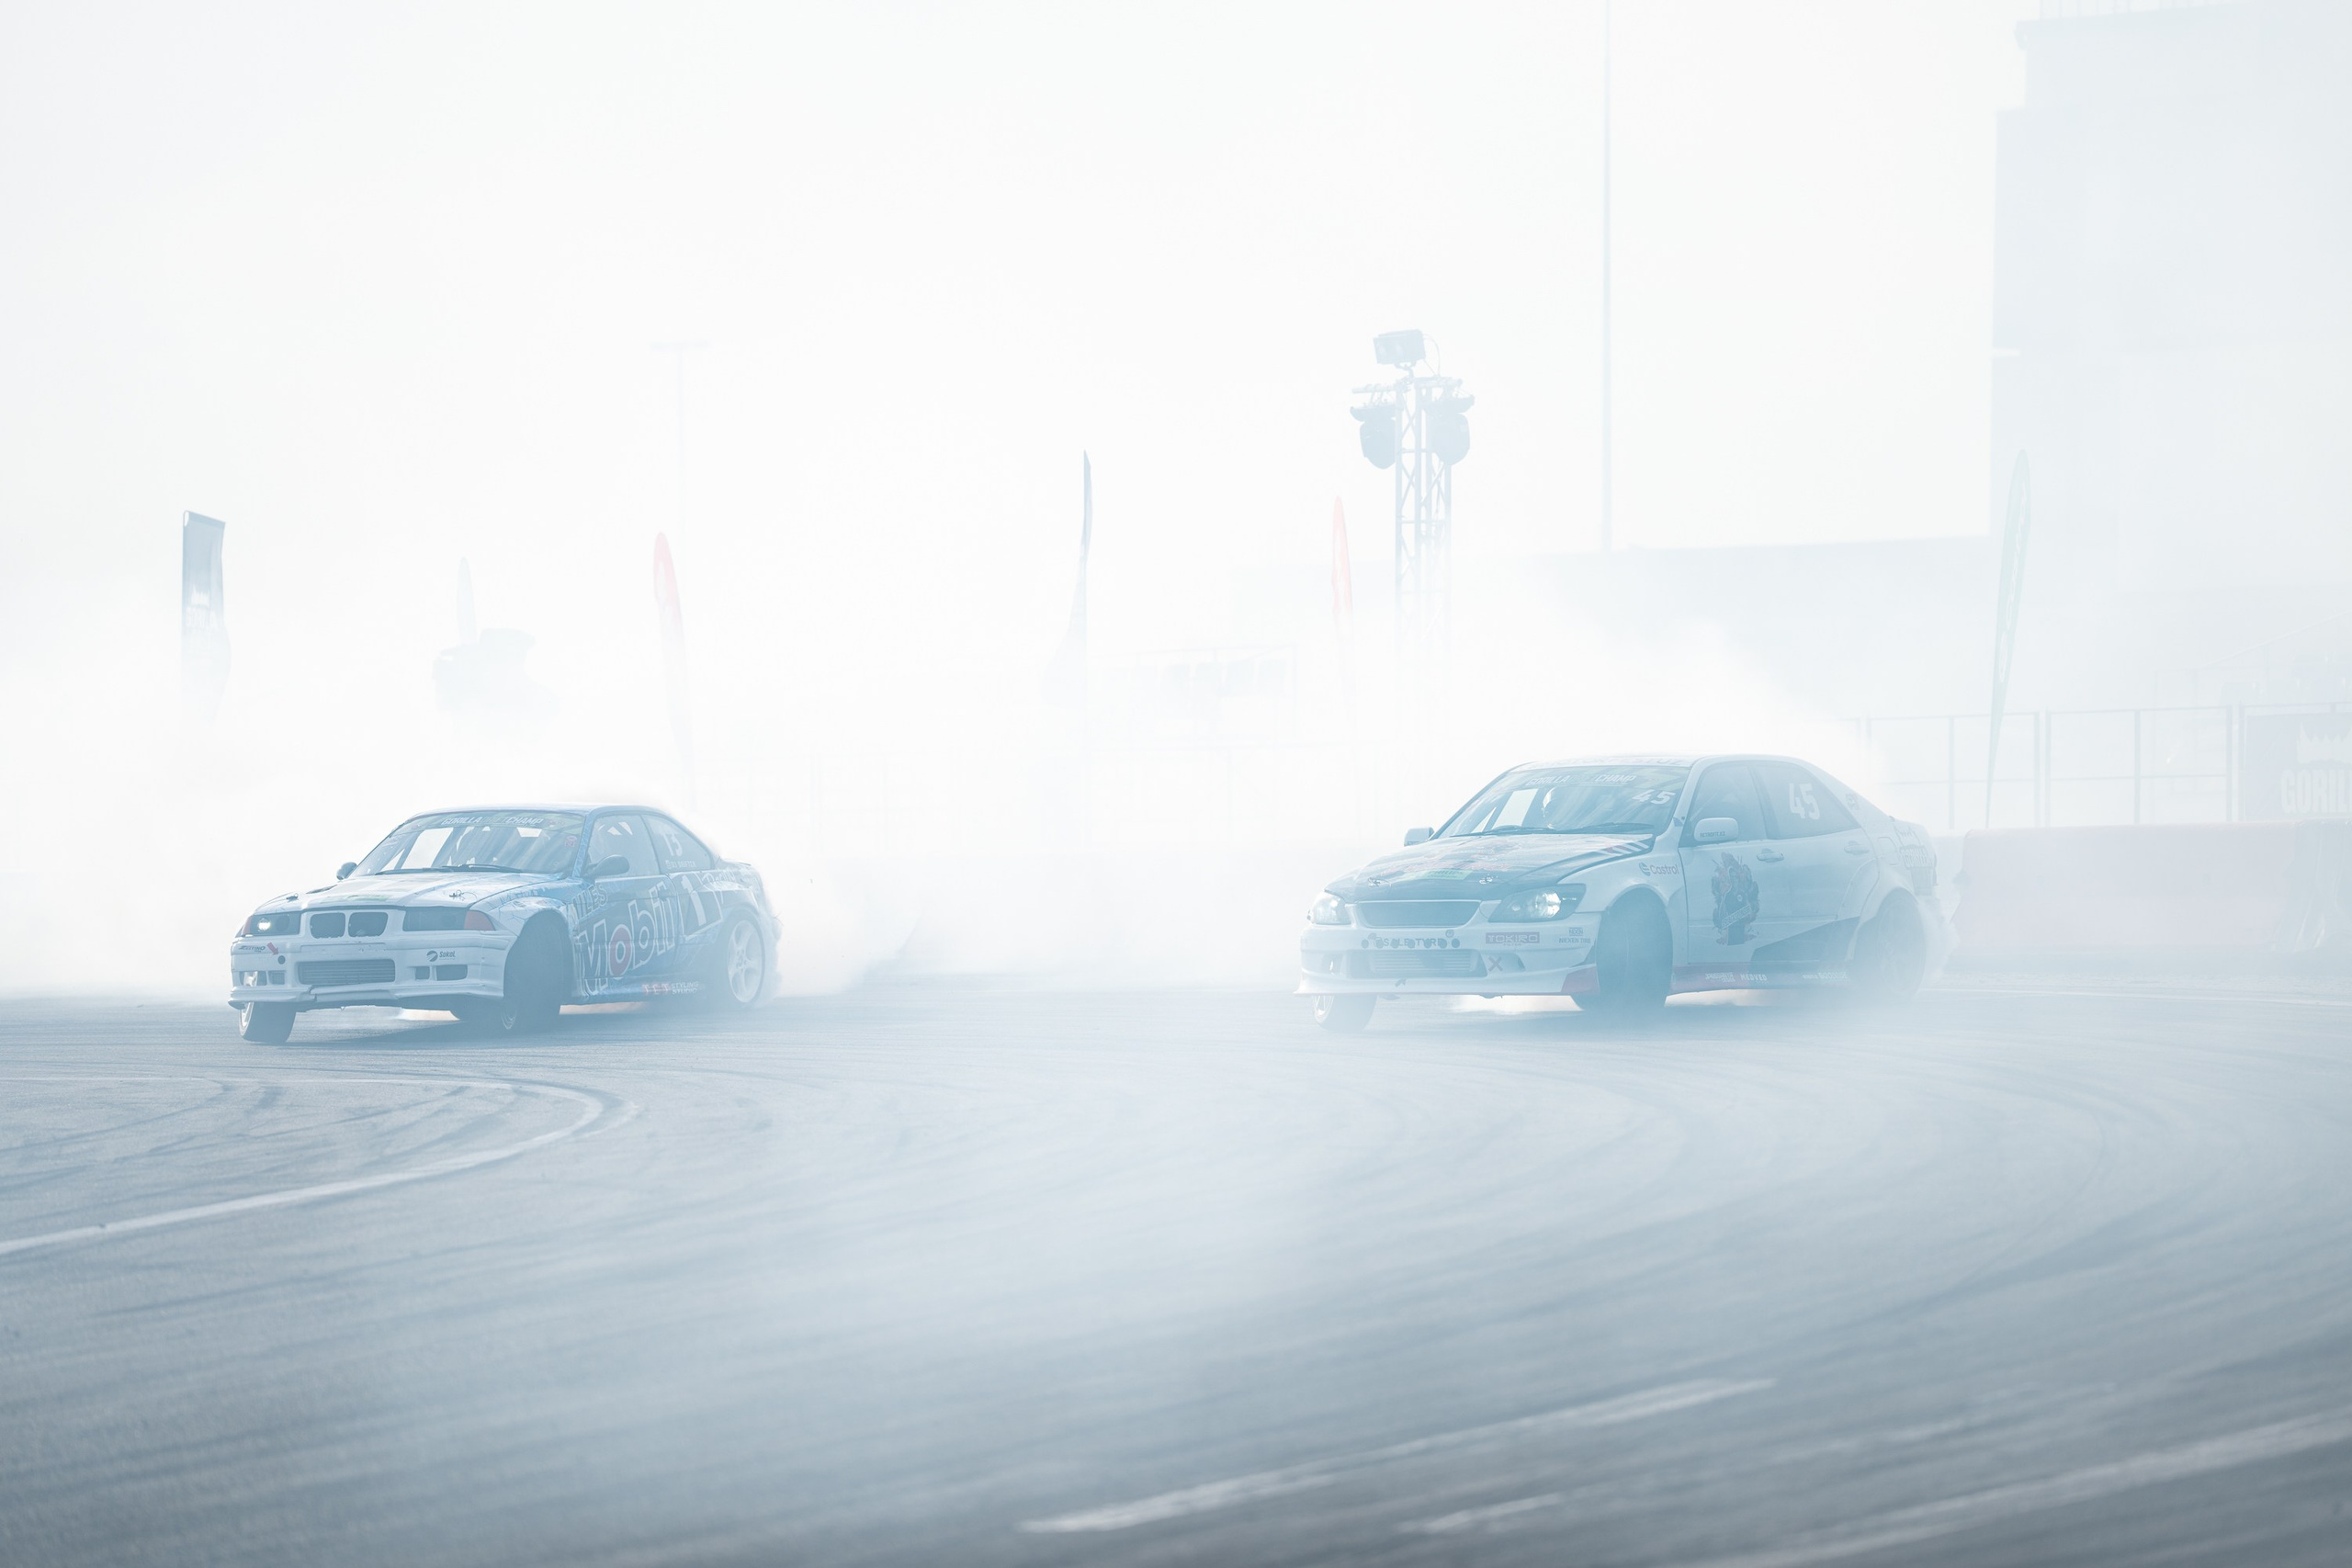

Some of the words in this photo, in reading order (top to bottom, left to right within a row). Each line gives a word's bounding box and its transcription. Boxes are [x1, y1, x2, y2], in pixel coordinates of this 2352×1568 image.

[1525, 775, 1570, 786] GORILLA
[1595, 773, 1637, 784] CHAMP
[1632, 789, 1676, 805] 45
[1789, 783, 1820, 820] 45
[1650, 863, 1679, 875] Castrol
[578, 881, 675, 995] Mobil
[1487, 934, 1538, 943] TOKIRO
